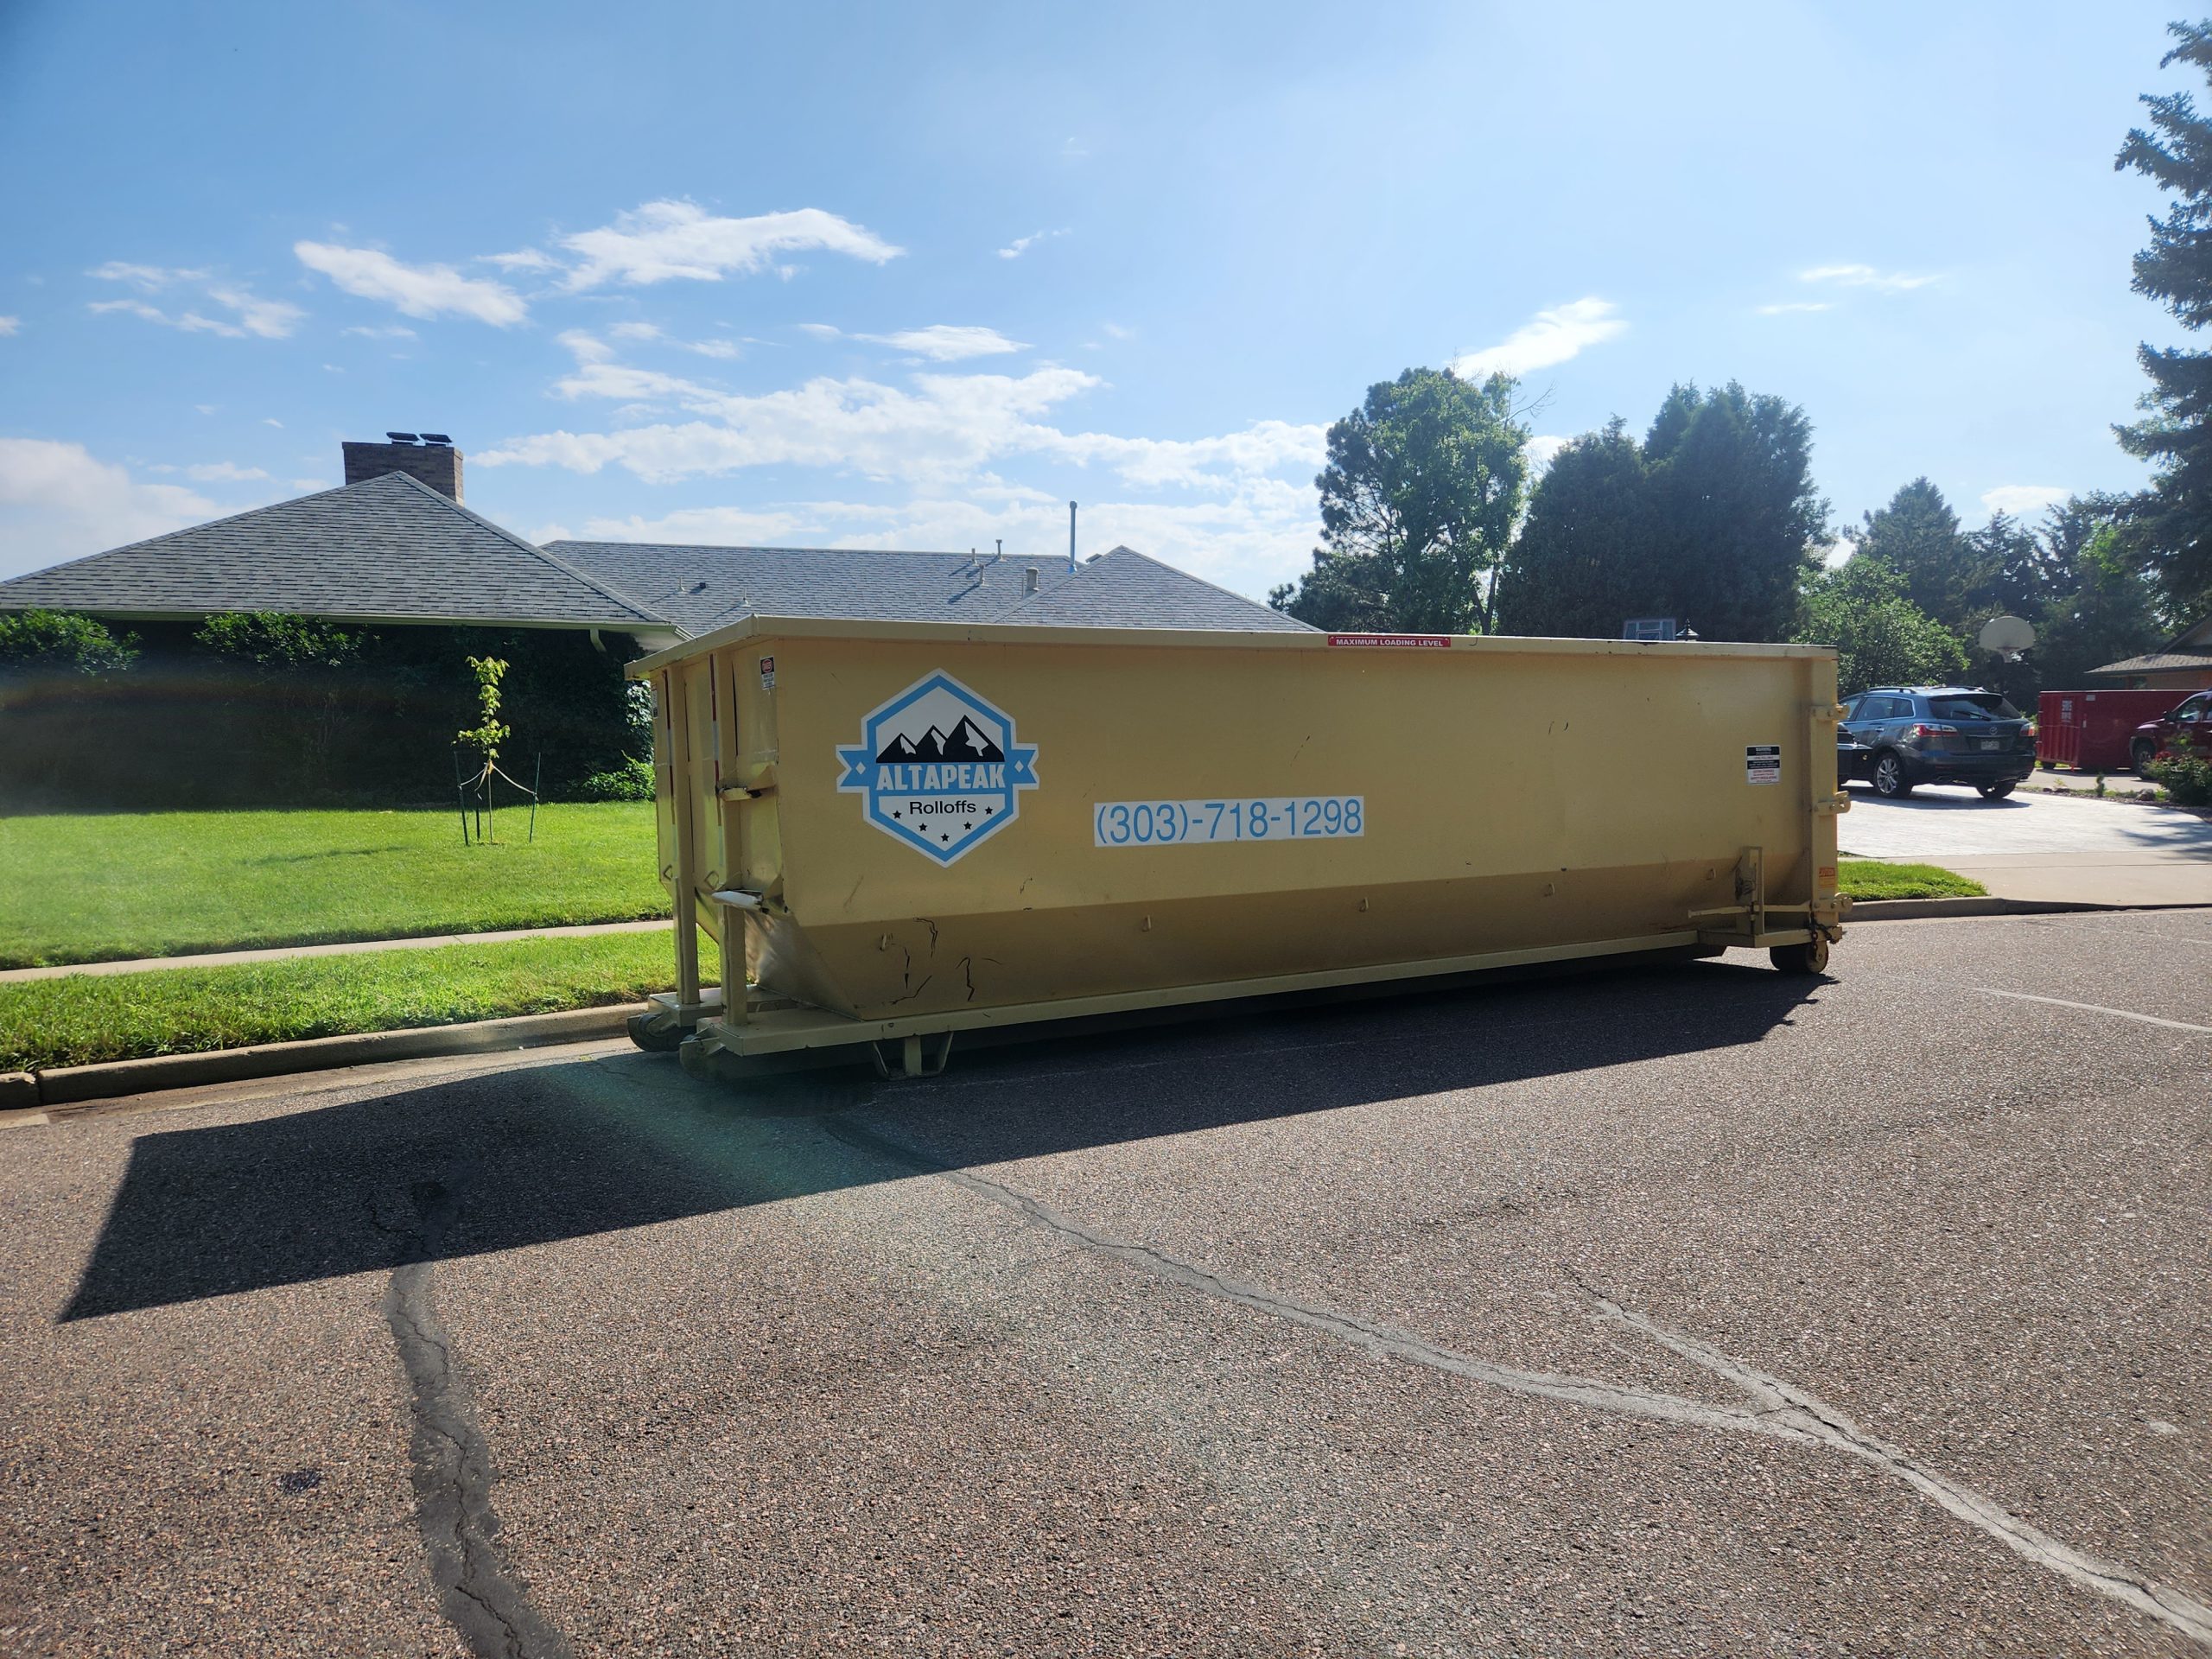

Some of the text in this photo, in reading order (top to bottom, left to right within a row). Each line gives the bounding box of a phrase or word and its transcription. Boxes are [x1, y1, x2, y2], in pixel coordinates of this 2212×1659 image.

[876, 764, 1007, 791] ALTAPEAK
[909, 800, 976, 815] Rolloffs
[1097, 798, 1362, 844] (303)-718-1298
